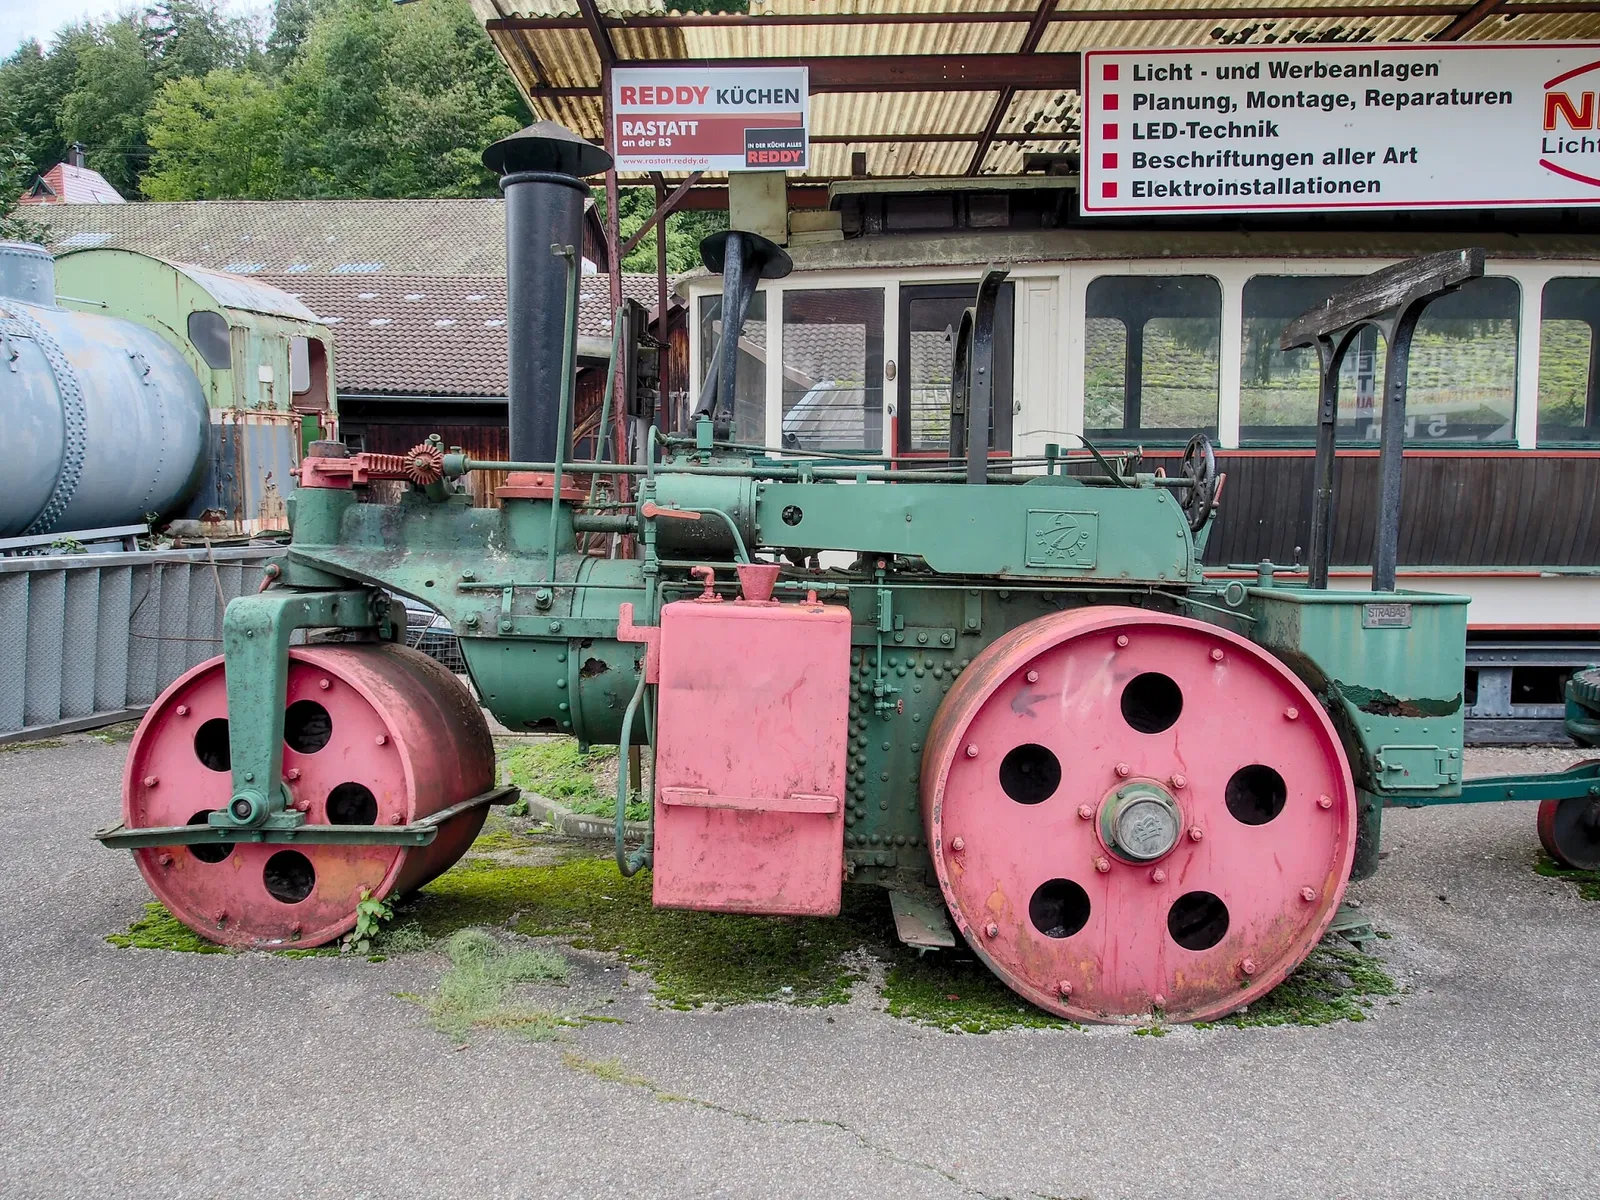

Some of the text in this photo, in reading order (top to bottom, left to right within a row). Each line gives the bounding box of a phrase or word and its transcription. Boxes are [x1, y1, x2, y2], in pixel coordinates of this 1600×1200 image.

[1133, 64, 1193, 81] Licht
[1216, 62, 1260, 80] und
[1268, 60, 1439, 82] Werbeanlagen
[620, 86, 800, 105] REDDY KÜCHEN
[1133, 88, 1513, 113] Planung, Montage, Reparaturen
[622, 121, 698, 136] RASTATT
[1132, 120, 1279, 140] LED-Technik
[622, 137, 672, 147] an der B3
[767, 141, 786, 149] KÜCHE
[623, 157, 709, 166] www.rastatt.reddy.de
[747, 151, 801, 163] REDDY
[1132, 147, 1418, 170] Beschriftungen aller Art
[1131, 176, 1381, 198] Elektroinstallationen
[1035, 529, 1089, 559] STRABAG
